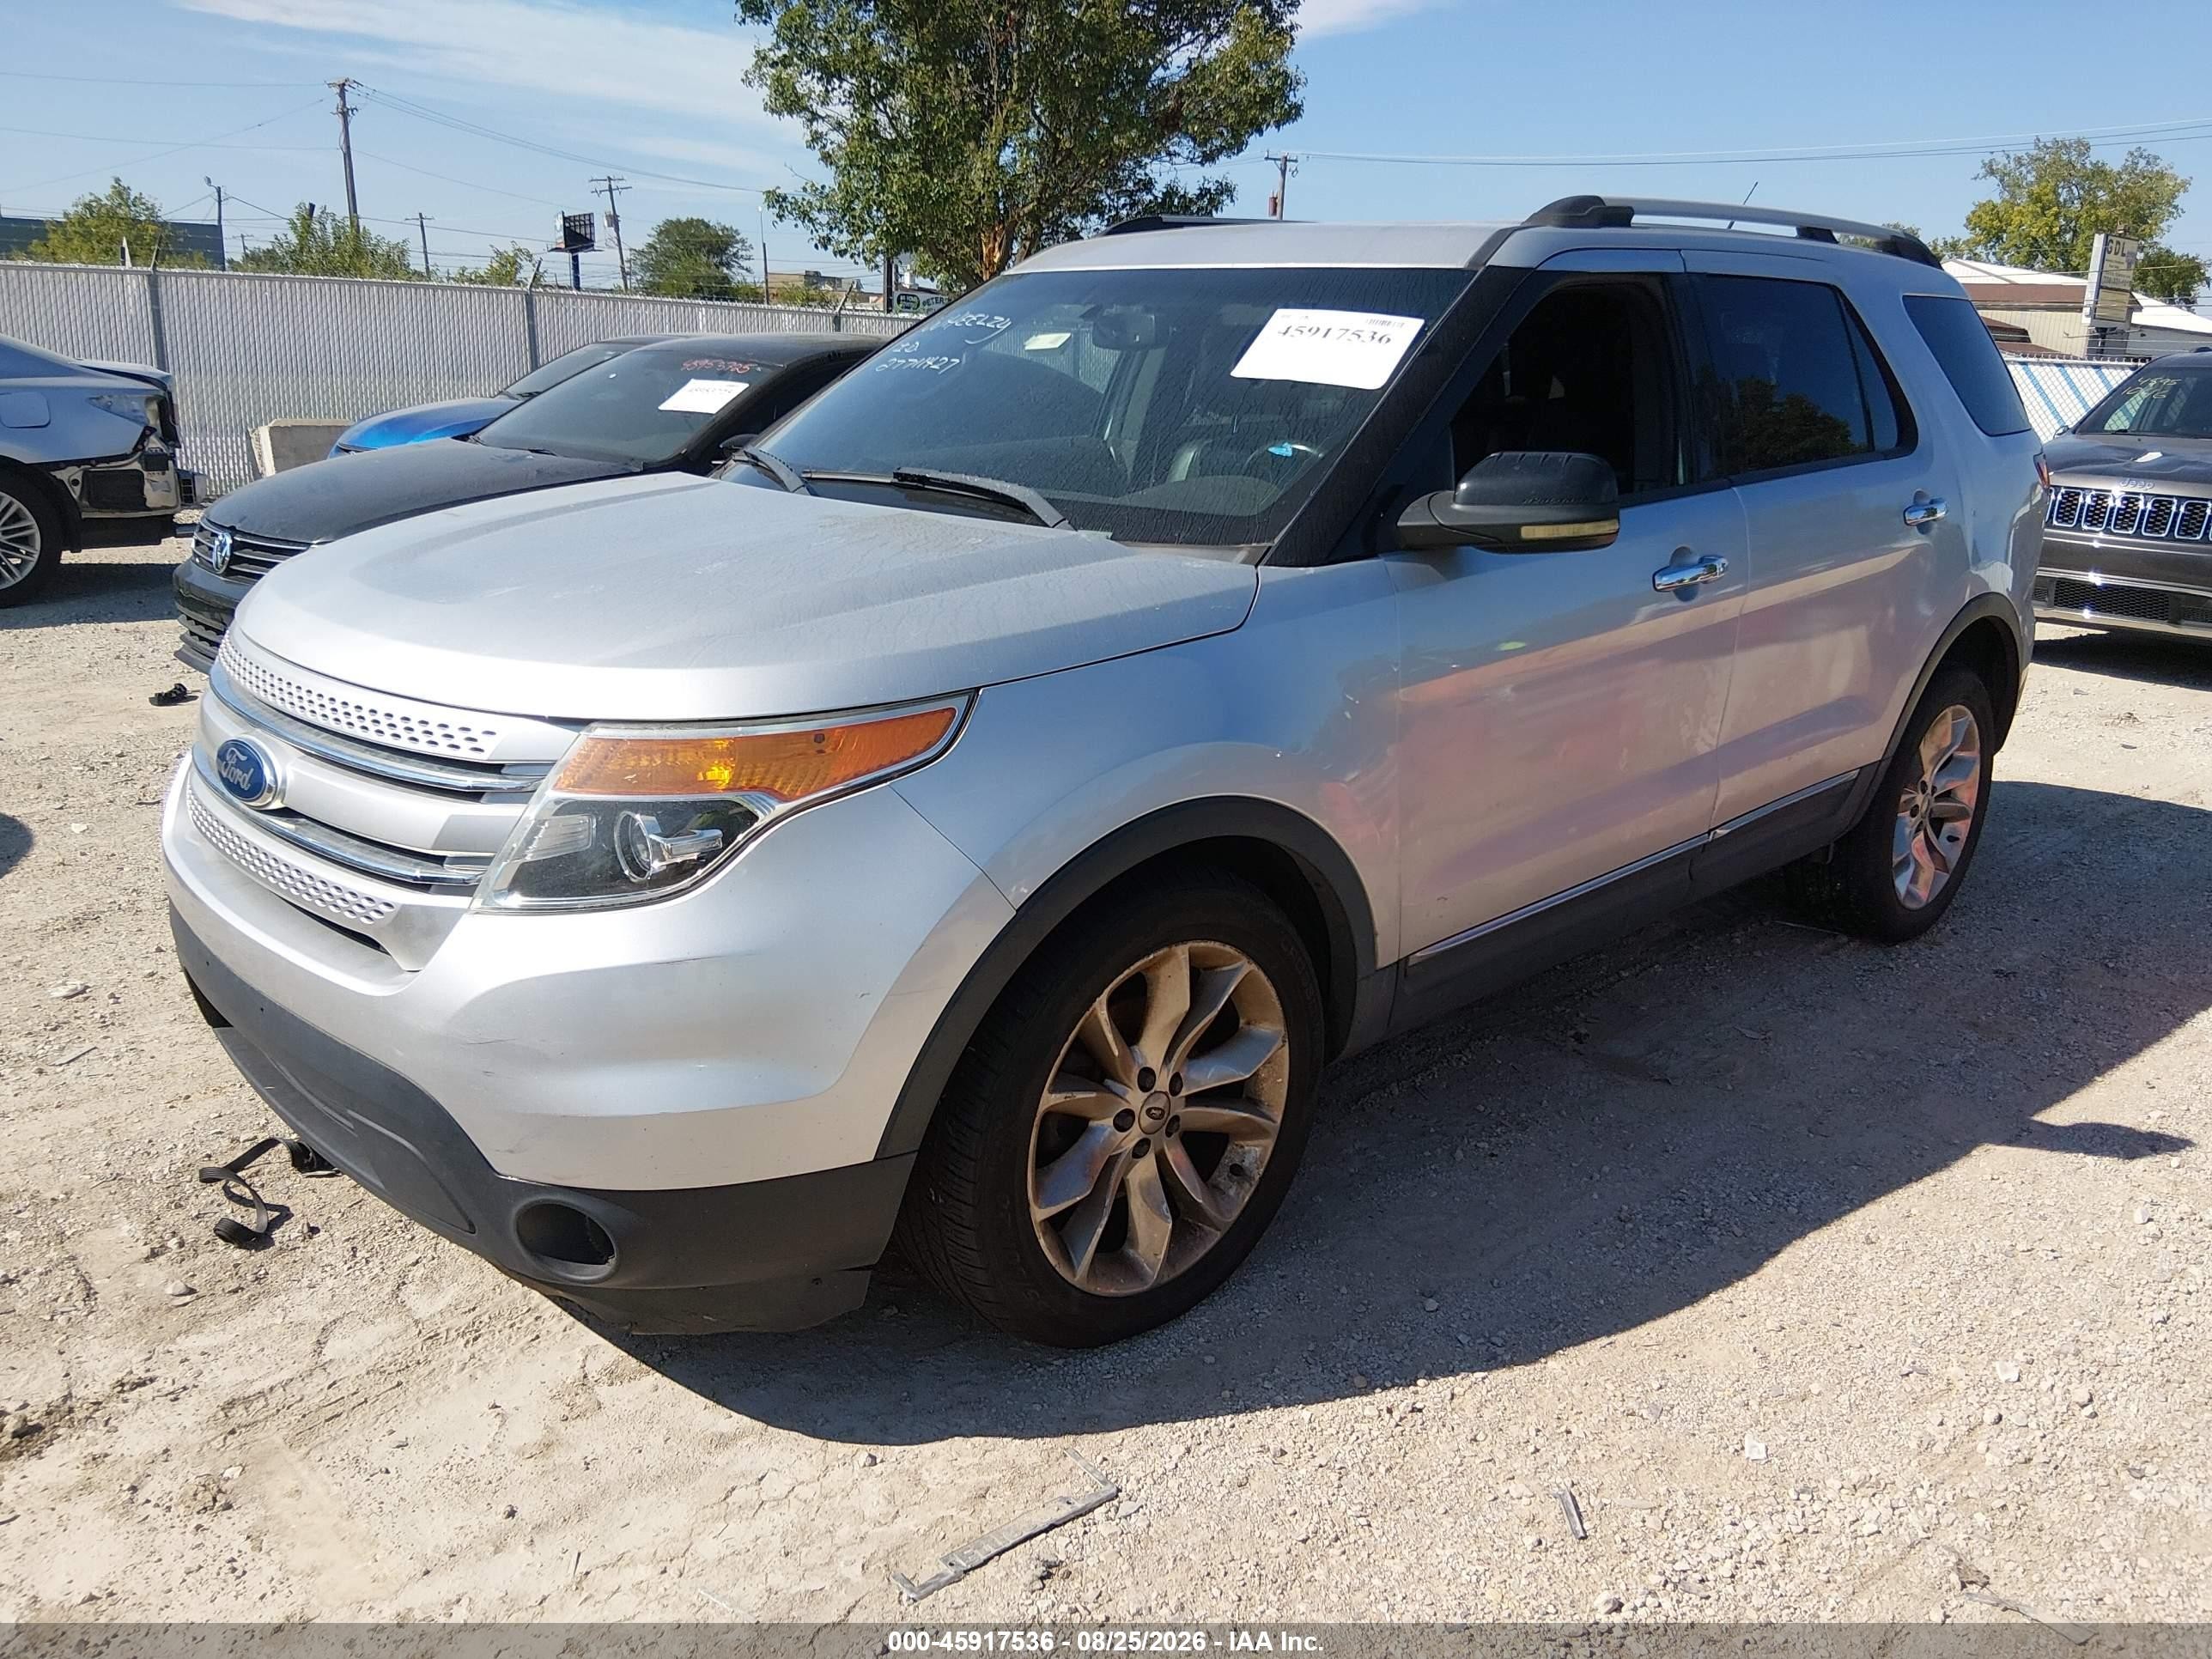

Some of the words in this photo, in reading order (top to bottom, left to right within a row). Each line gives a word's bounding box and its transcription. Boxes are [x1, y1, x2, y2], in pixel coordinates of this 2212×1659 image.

[2106, 239, 2126, 257] GDL
[1278, 325, 1391, 344] 45917536
[2118, 477, 2155, 491] Jeep
[221, 747, 254, 791] Ford
